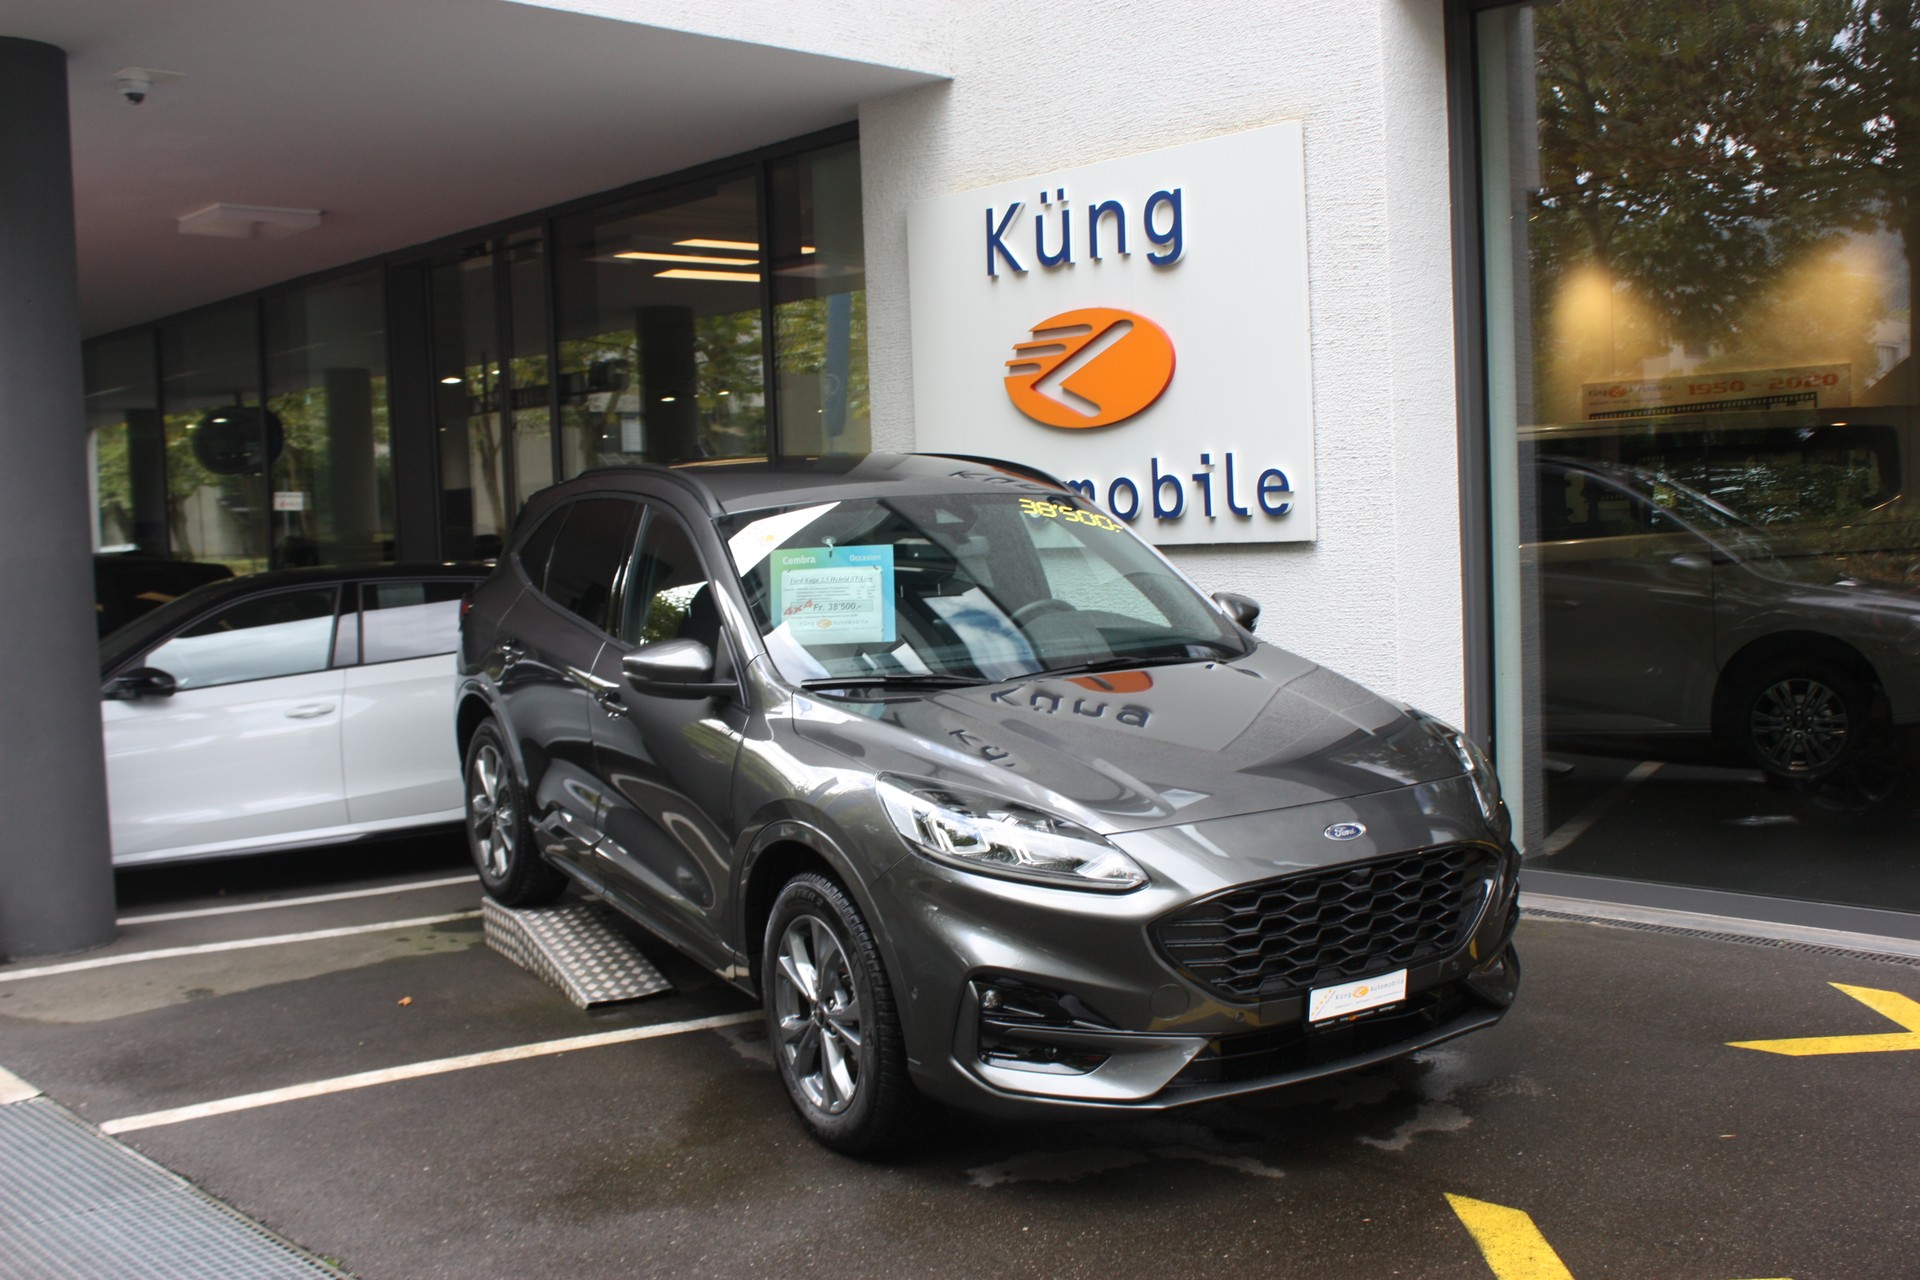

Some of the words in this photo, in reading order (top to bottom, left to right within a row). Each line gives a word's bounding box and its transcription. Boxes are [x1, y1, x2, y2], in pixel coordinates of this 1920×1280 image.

[986, 188, 1186, 276] Küng
[1688, 381, 1745, 396] 1950
[1769, 373, 1839, 390] 2020
[1066, 452, 1294, 522] mobile
[782, 555, 816, 565] Cembra
[849, 554, 881, 562] Occasion
[813, 603, 825, 612] Fr.
[1333, 826, 1357, 838] Ford
[1335, 992, 1352, 1000] Küng
[1370, 979, 1404, 992] Automobile
